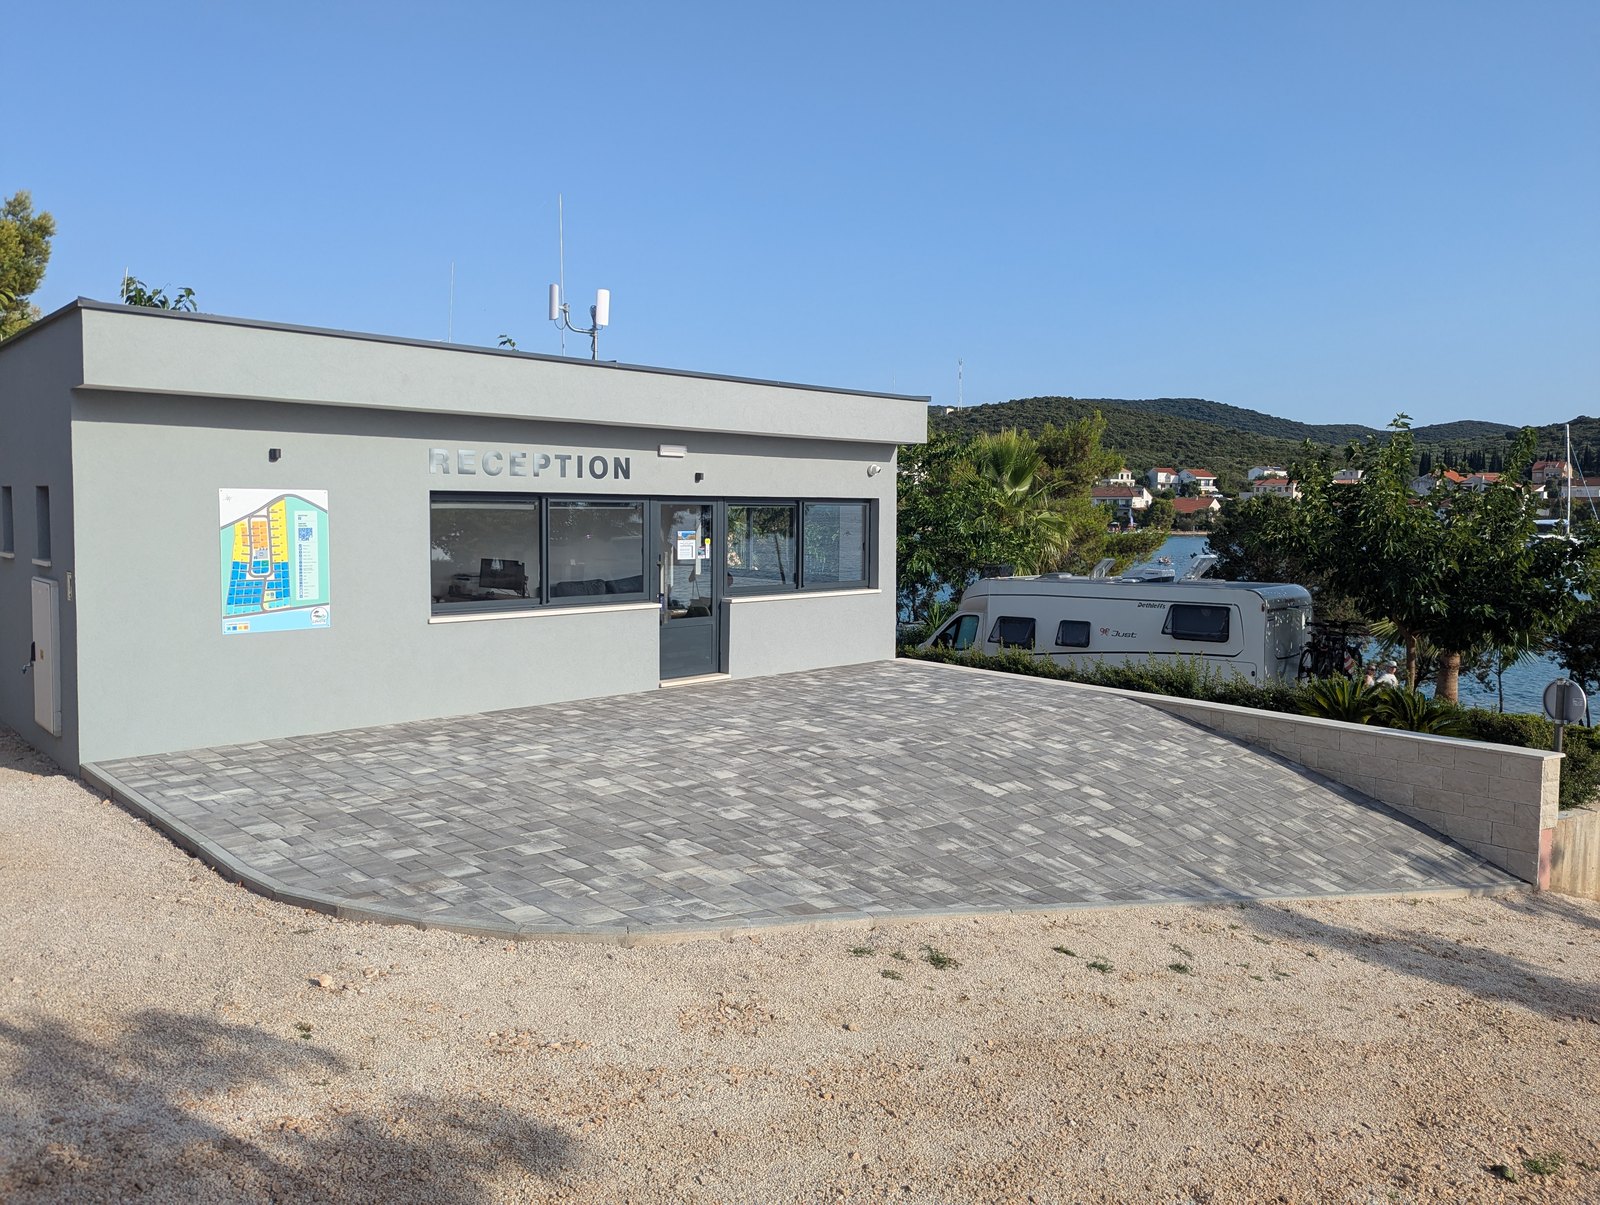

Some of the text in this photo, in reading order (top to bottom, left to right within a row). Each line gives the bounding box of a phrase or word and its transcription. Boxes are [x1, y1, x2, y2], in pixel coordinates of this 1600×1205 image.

[428, 447, 631, 480] RECEPTION
[1137, 602, 1166, 610] Dethleffs
[1111, 630, 1137, 638] Just
